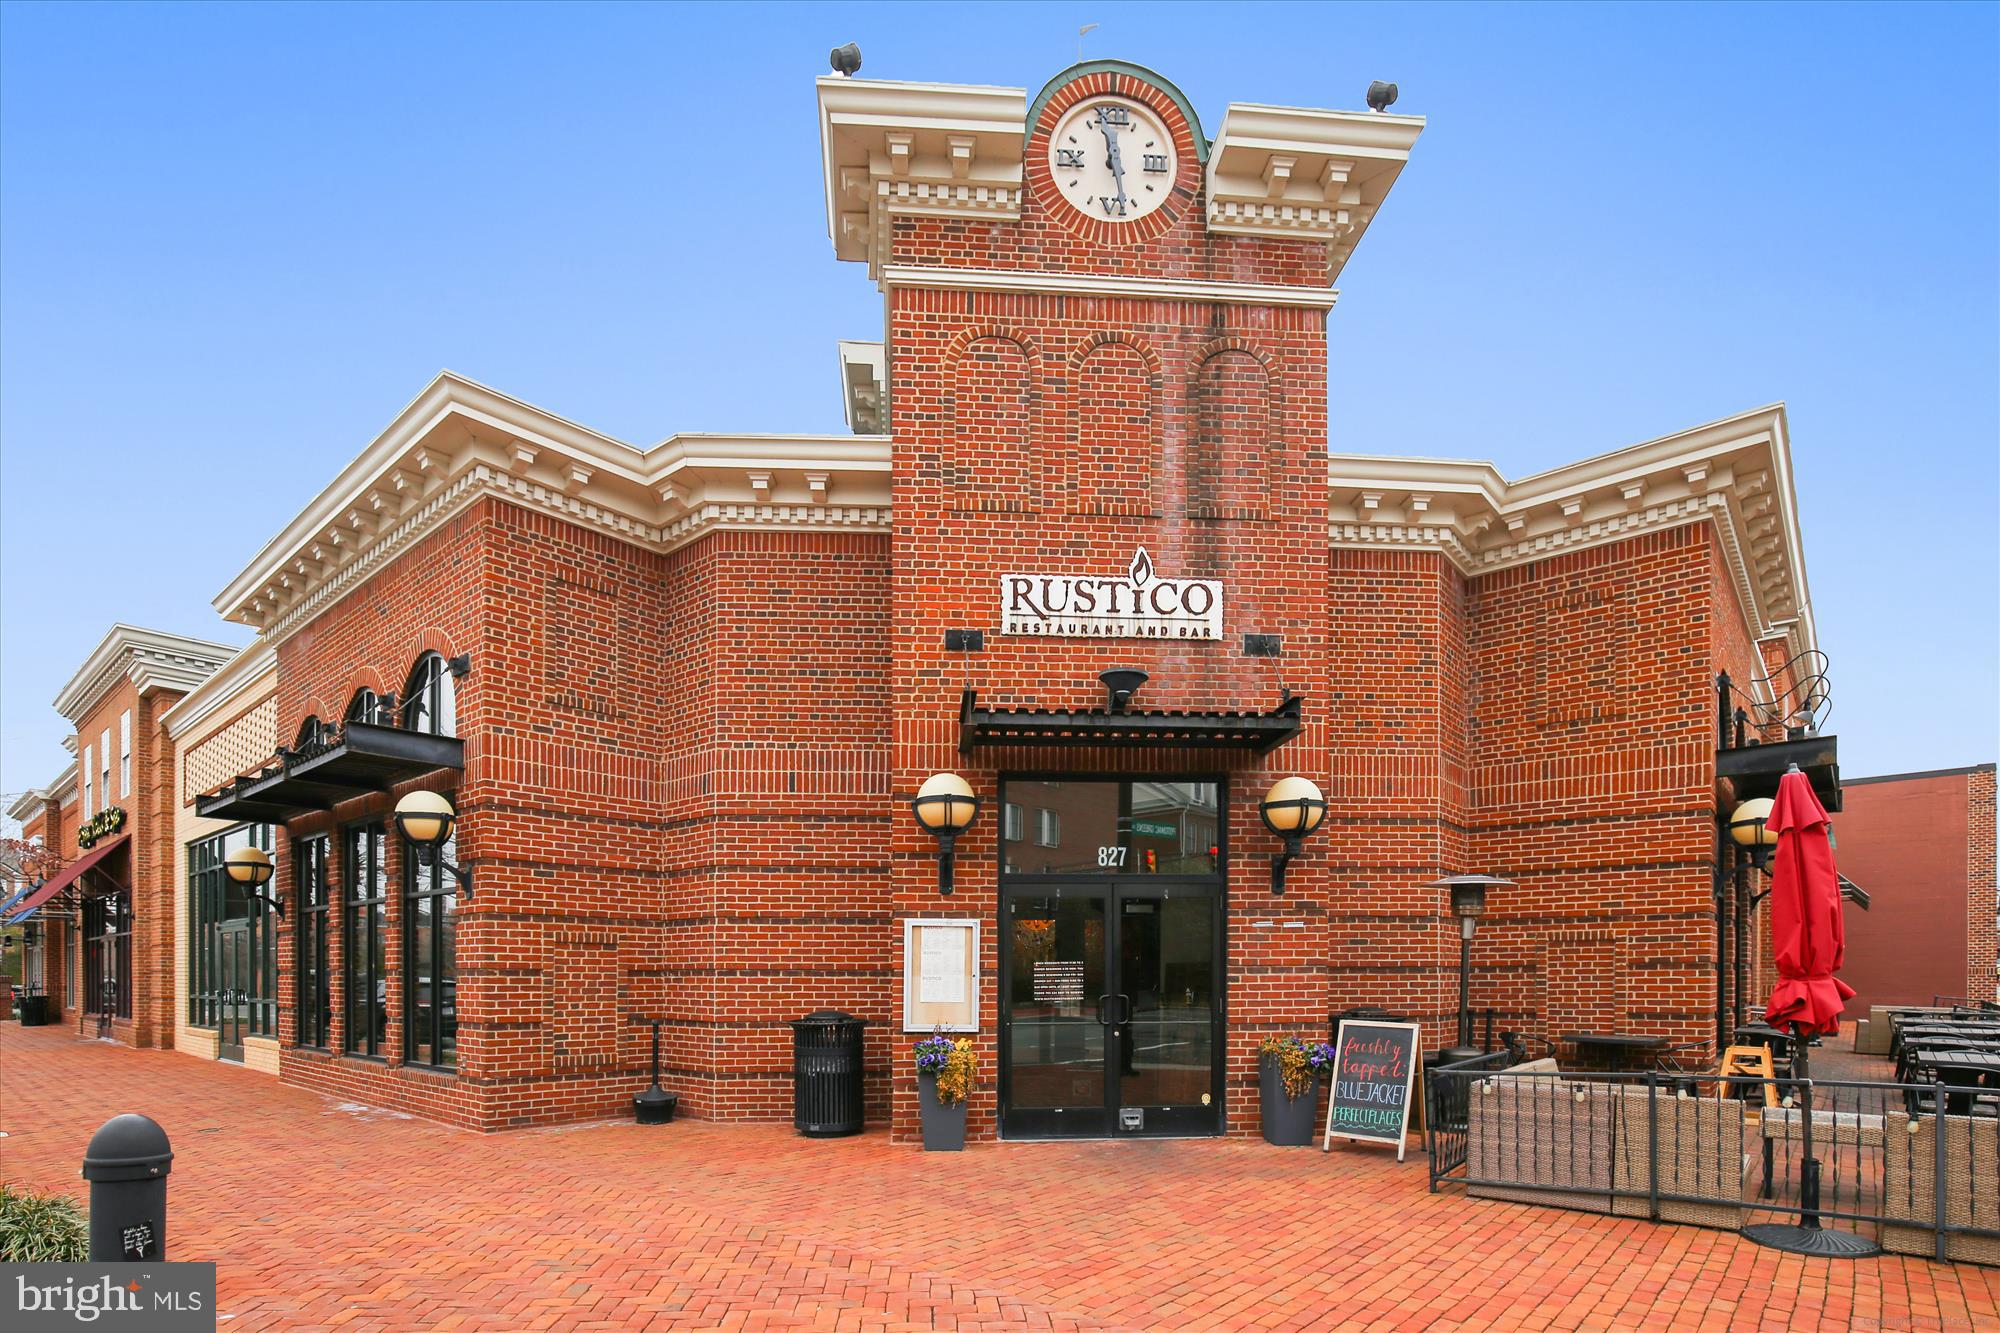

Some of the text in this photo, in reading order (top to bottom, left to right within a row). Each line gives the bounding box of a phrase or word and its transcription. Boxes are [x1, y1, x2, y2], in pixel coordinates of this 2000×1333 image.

[1094, 107, 1130, 126] XII
[1057, 149, 1085, 168] IX
[1143, 154, 1168, 173] III
[1010, 622, 1211, 637] RESTAURANT AND BAR
[1097, 846, 1127, 867] 827
[1343, 1037, 1401, 1062] freshly
[1336, 1081, 1407, 1105] BLUEJACKET
